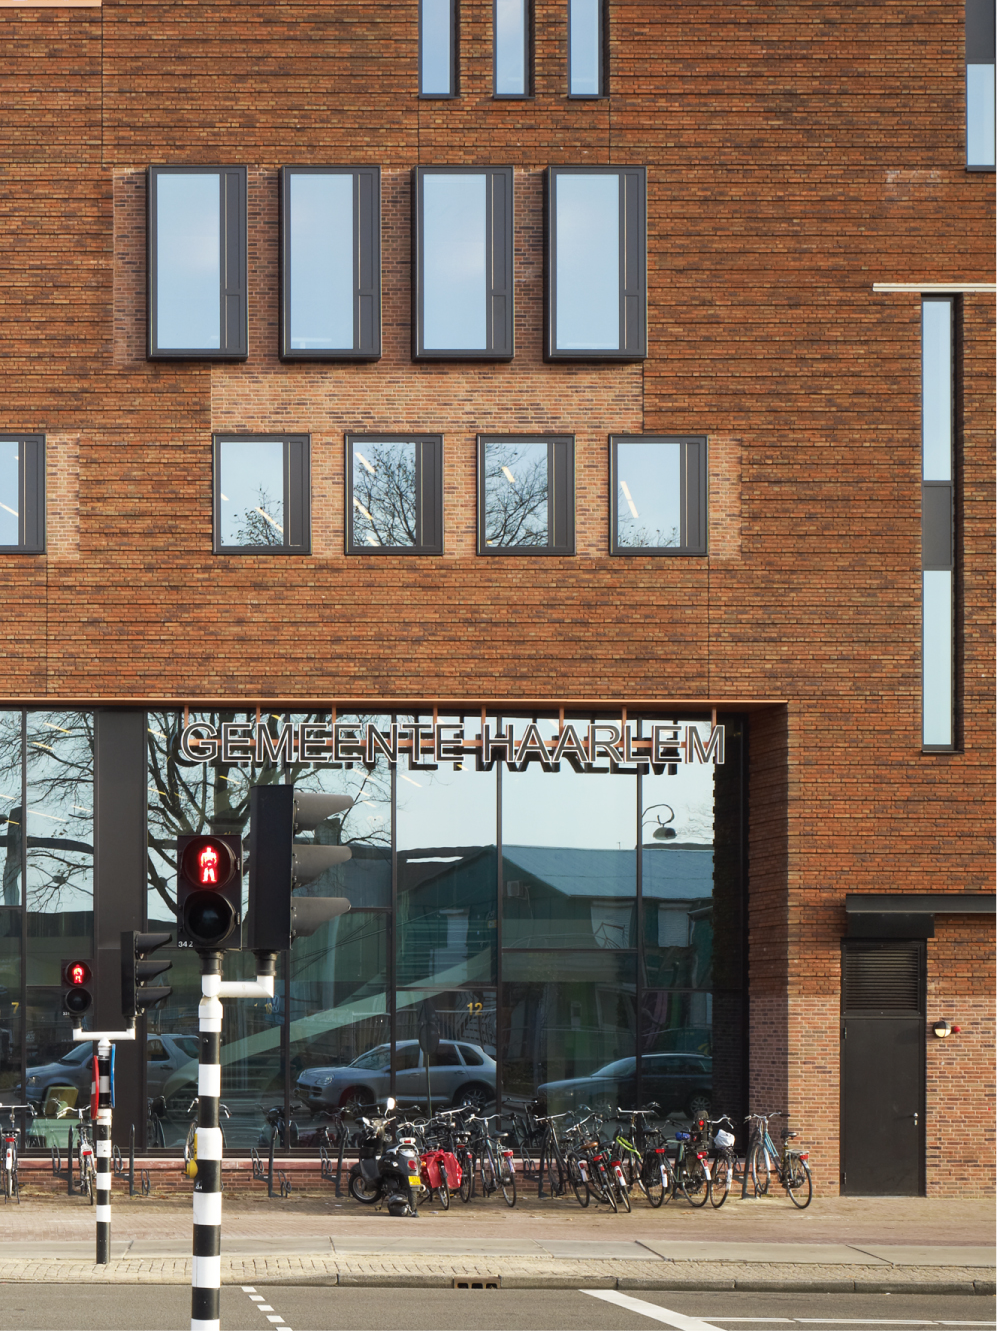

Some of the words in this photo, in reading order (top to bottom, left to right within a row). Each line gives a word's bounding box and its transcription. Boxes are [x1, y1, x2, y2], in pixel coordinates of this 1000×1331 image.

[180, 720, 465, 764] GEMEENTE
[482, 723, 726, 766] HAARLEM
[11, 1002, 20, 1015] 7
[466, 1002, 483, 1016] 12
